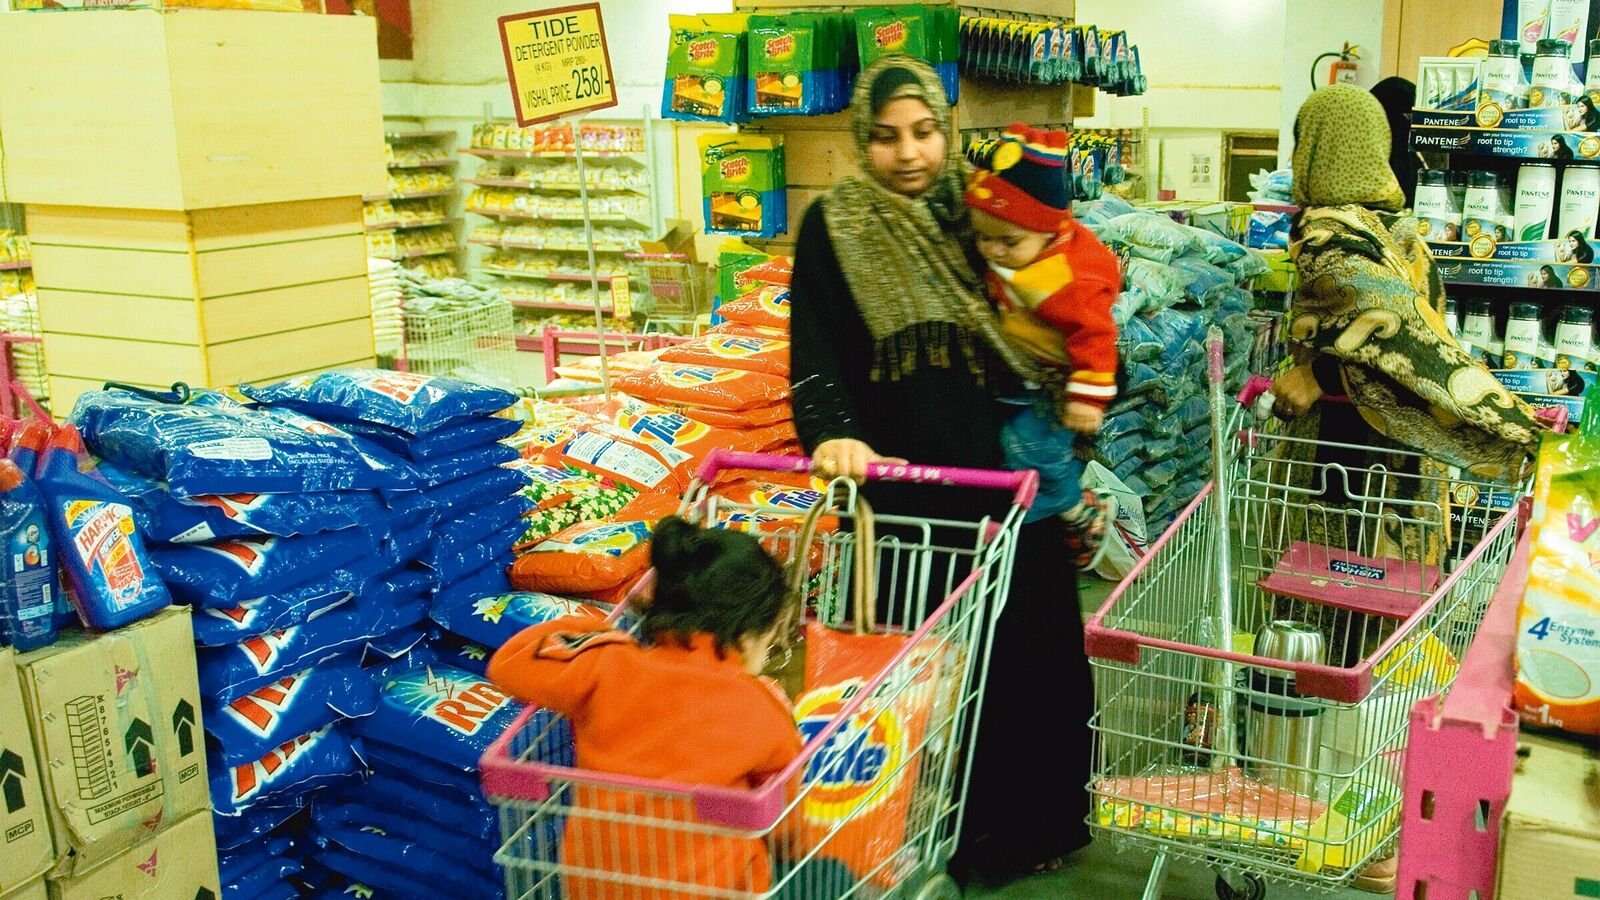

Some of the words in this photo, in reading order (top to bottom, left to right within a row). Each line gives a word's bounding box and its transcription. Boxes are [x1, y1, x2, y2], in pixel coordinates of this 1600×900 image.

[528, 16, 580, 39] TIDE
[883, 32, 903, 45] Brite
[515, 39, 566, 61] DETERGENT
[567, 33, 602, 52] POWDER
[771, 46, 791, 57] Brite
[695, 50, 715, 60] Brite
[561, 58, 574, 67] MRP
[524, 86, 552, 109] VISHAL
[550, 83, 572, 106] PRICE
[572, 64, 610, 99] 258/-
[1424, 118, 1459, 126] PANTENE
[1528, 117, 1536, 125] tip
[1415, 135, 1459, 146] PANTENE
[1503, 138, 1513, 147] tip
[1492, 147, 1527, 155] strength?
[727, 167, 746, 177] Brite
[1494, 268, 1503, 276] tip
[1483, 276, 1517, 285] strength?
[632, 414, 689, 446] Tide
[877, 465, 940, 481] MEGA
[769, 490, 824, 509] Tide
[1502, 499, 1510, 507] tip
[1450, 513, 1491, 525] PATENE
[1332, 564, 1380, 579] VISHAL
[1528, 617, 1551, 640] 4
[1550, 622, 1595, 637] Enzyme
[1560, 632, 1600, 647] System
[798, 719, 886, 784] Tide
[181, 766, 197, 779] MCP
[94, 797, 121, 814] MAXIMUM
[121, 785, 156, 804] PERMISSIBLE
[103, 806, 121, 818] STACK
[121, 799, 142, 811] HEIGHT
[9, 823, 31, 839] MCP
